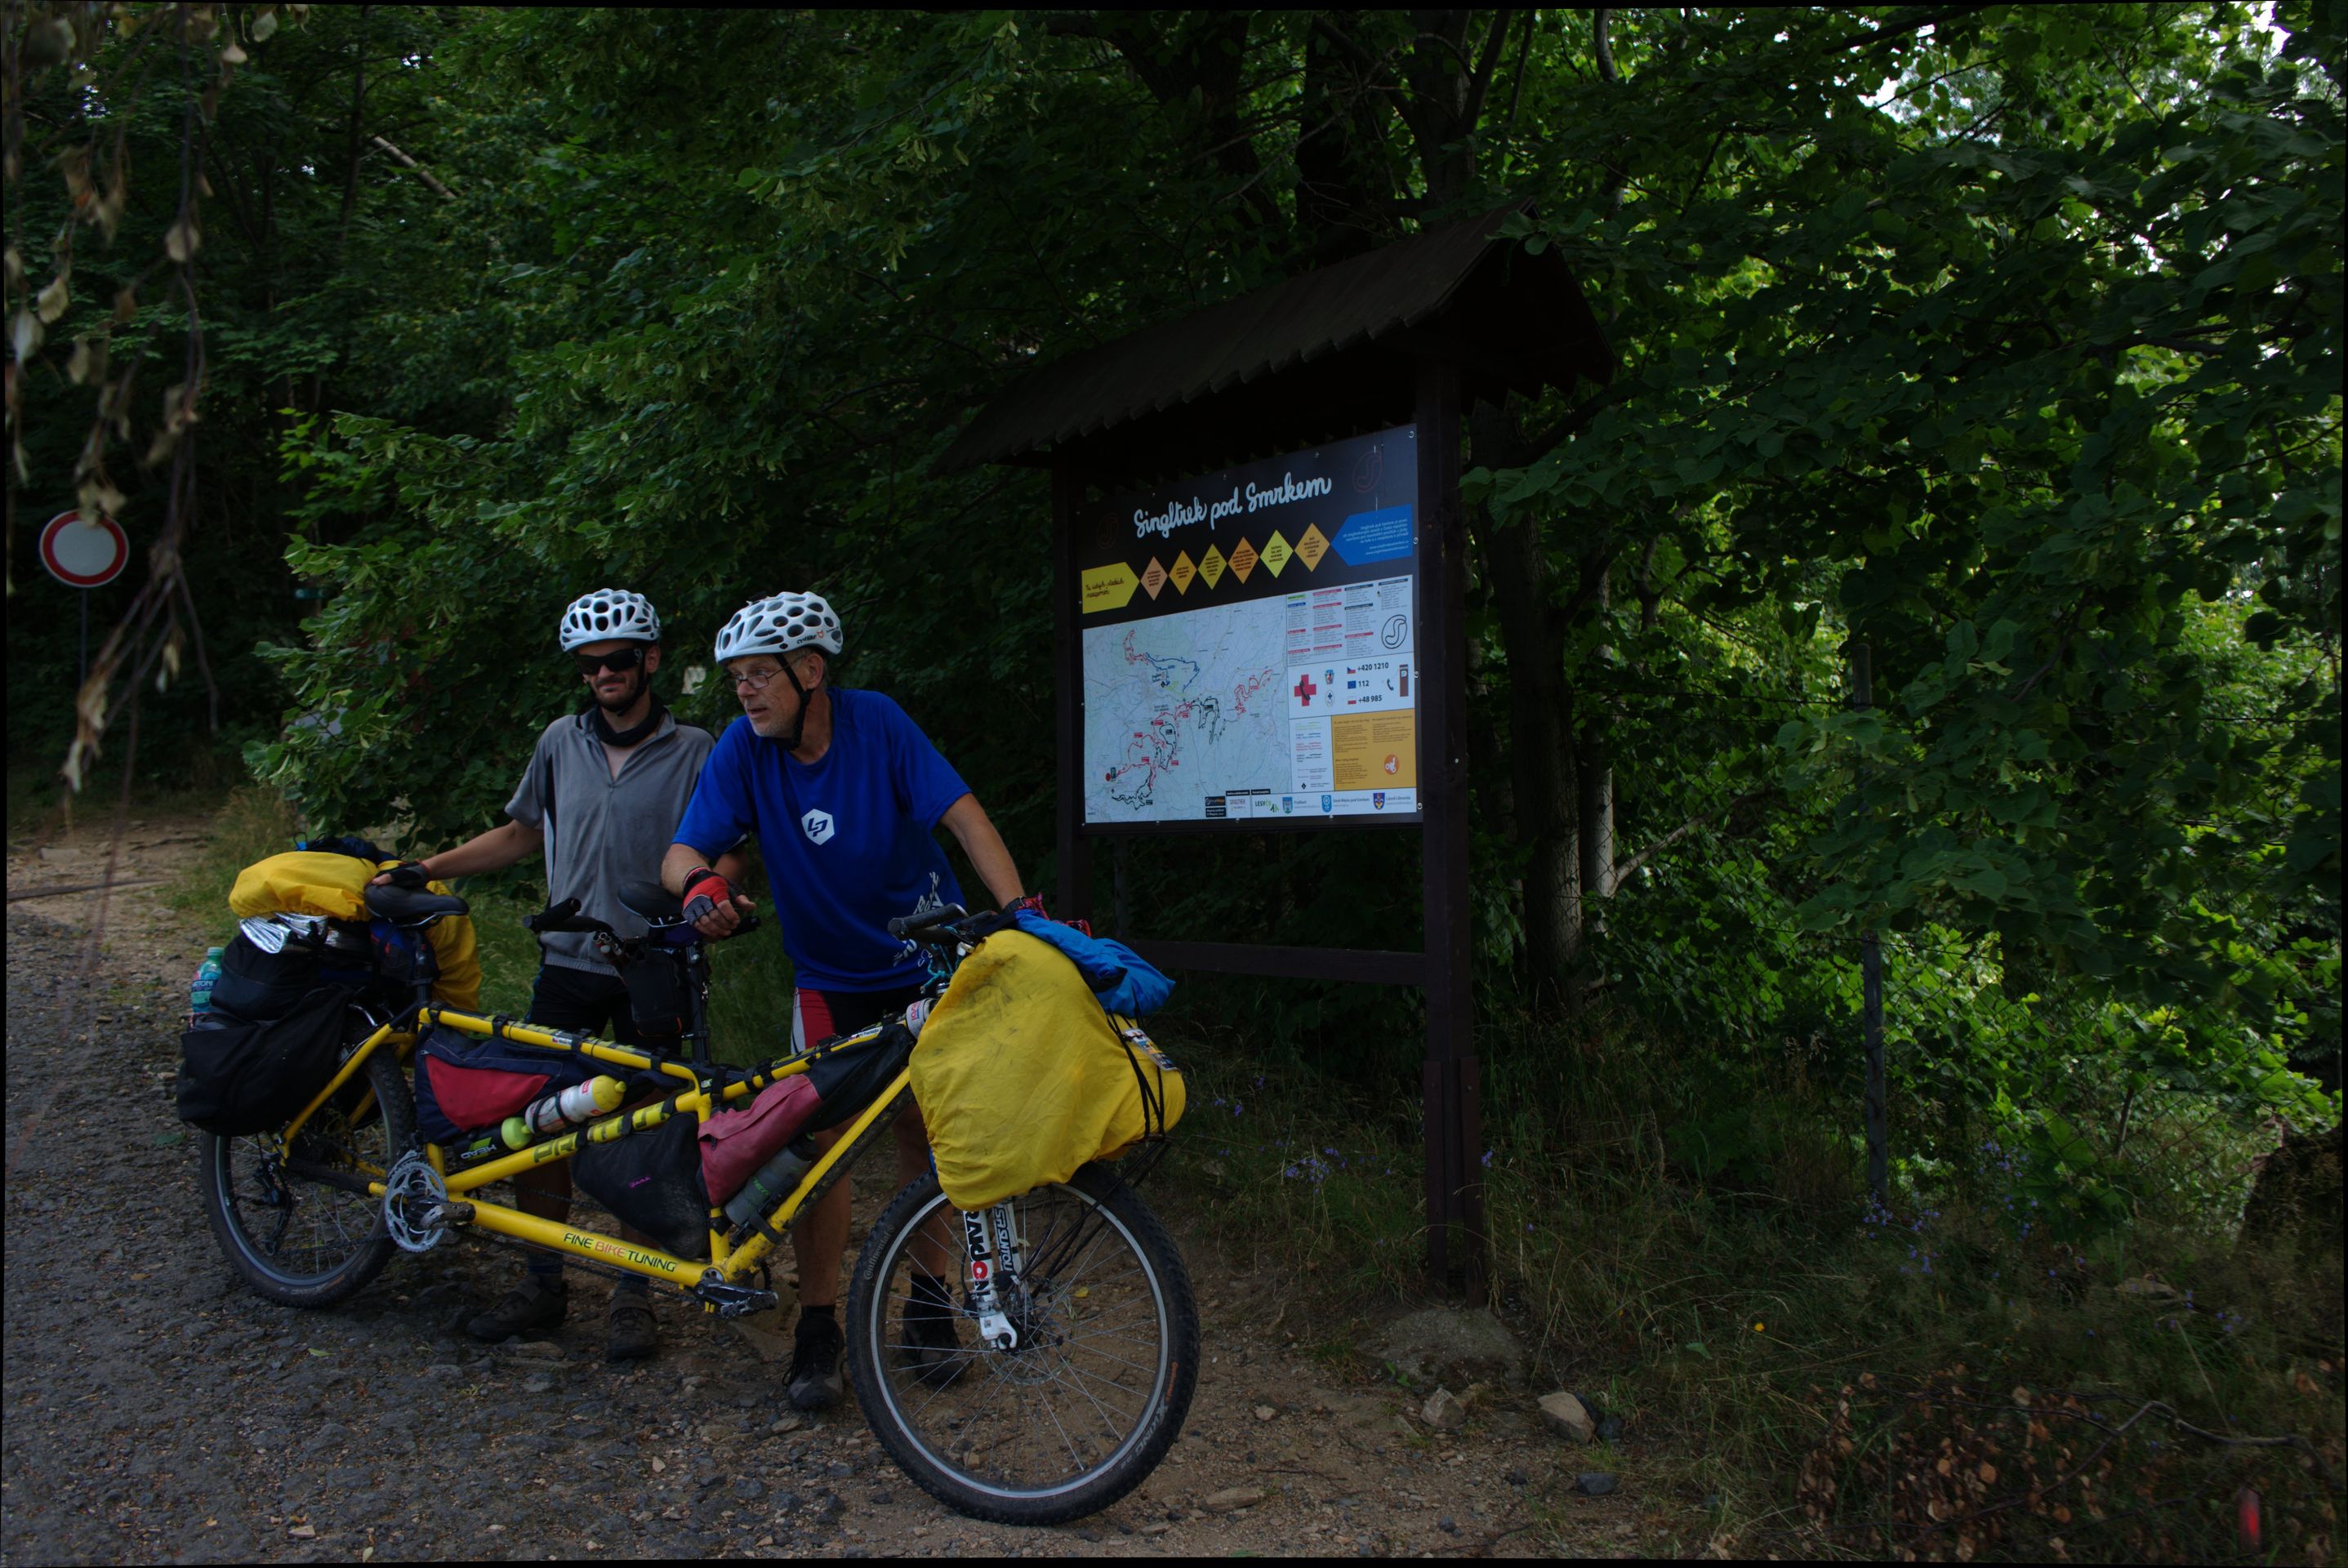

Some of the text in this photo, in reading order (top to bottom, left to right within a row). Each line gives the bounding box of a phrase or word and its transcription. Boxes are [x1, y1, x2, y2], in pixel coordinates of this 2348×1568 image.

[1134, 471, 1332, 539] Singltrek pod Smrkem
[1357, 662, 1389, 671] +420 1210
[1358, 694, 1383, 703] +48 985
[564, 1232, 678, 1272] FINE BIKE TUNING
[997, 1227, 1014, 1272] SUNTOU
